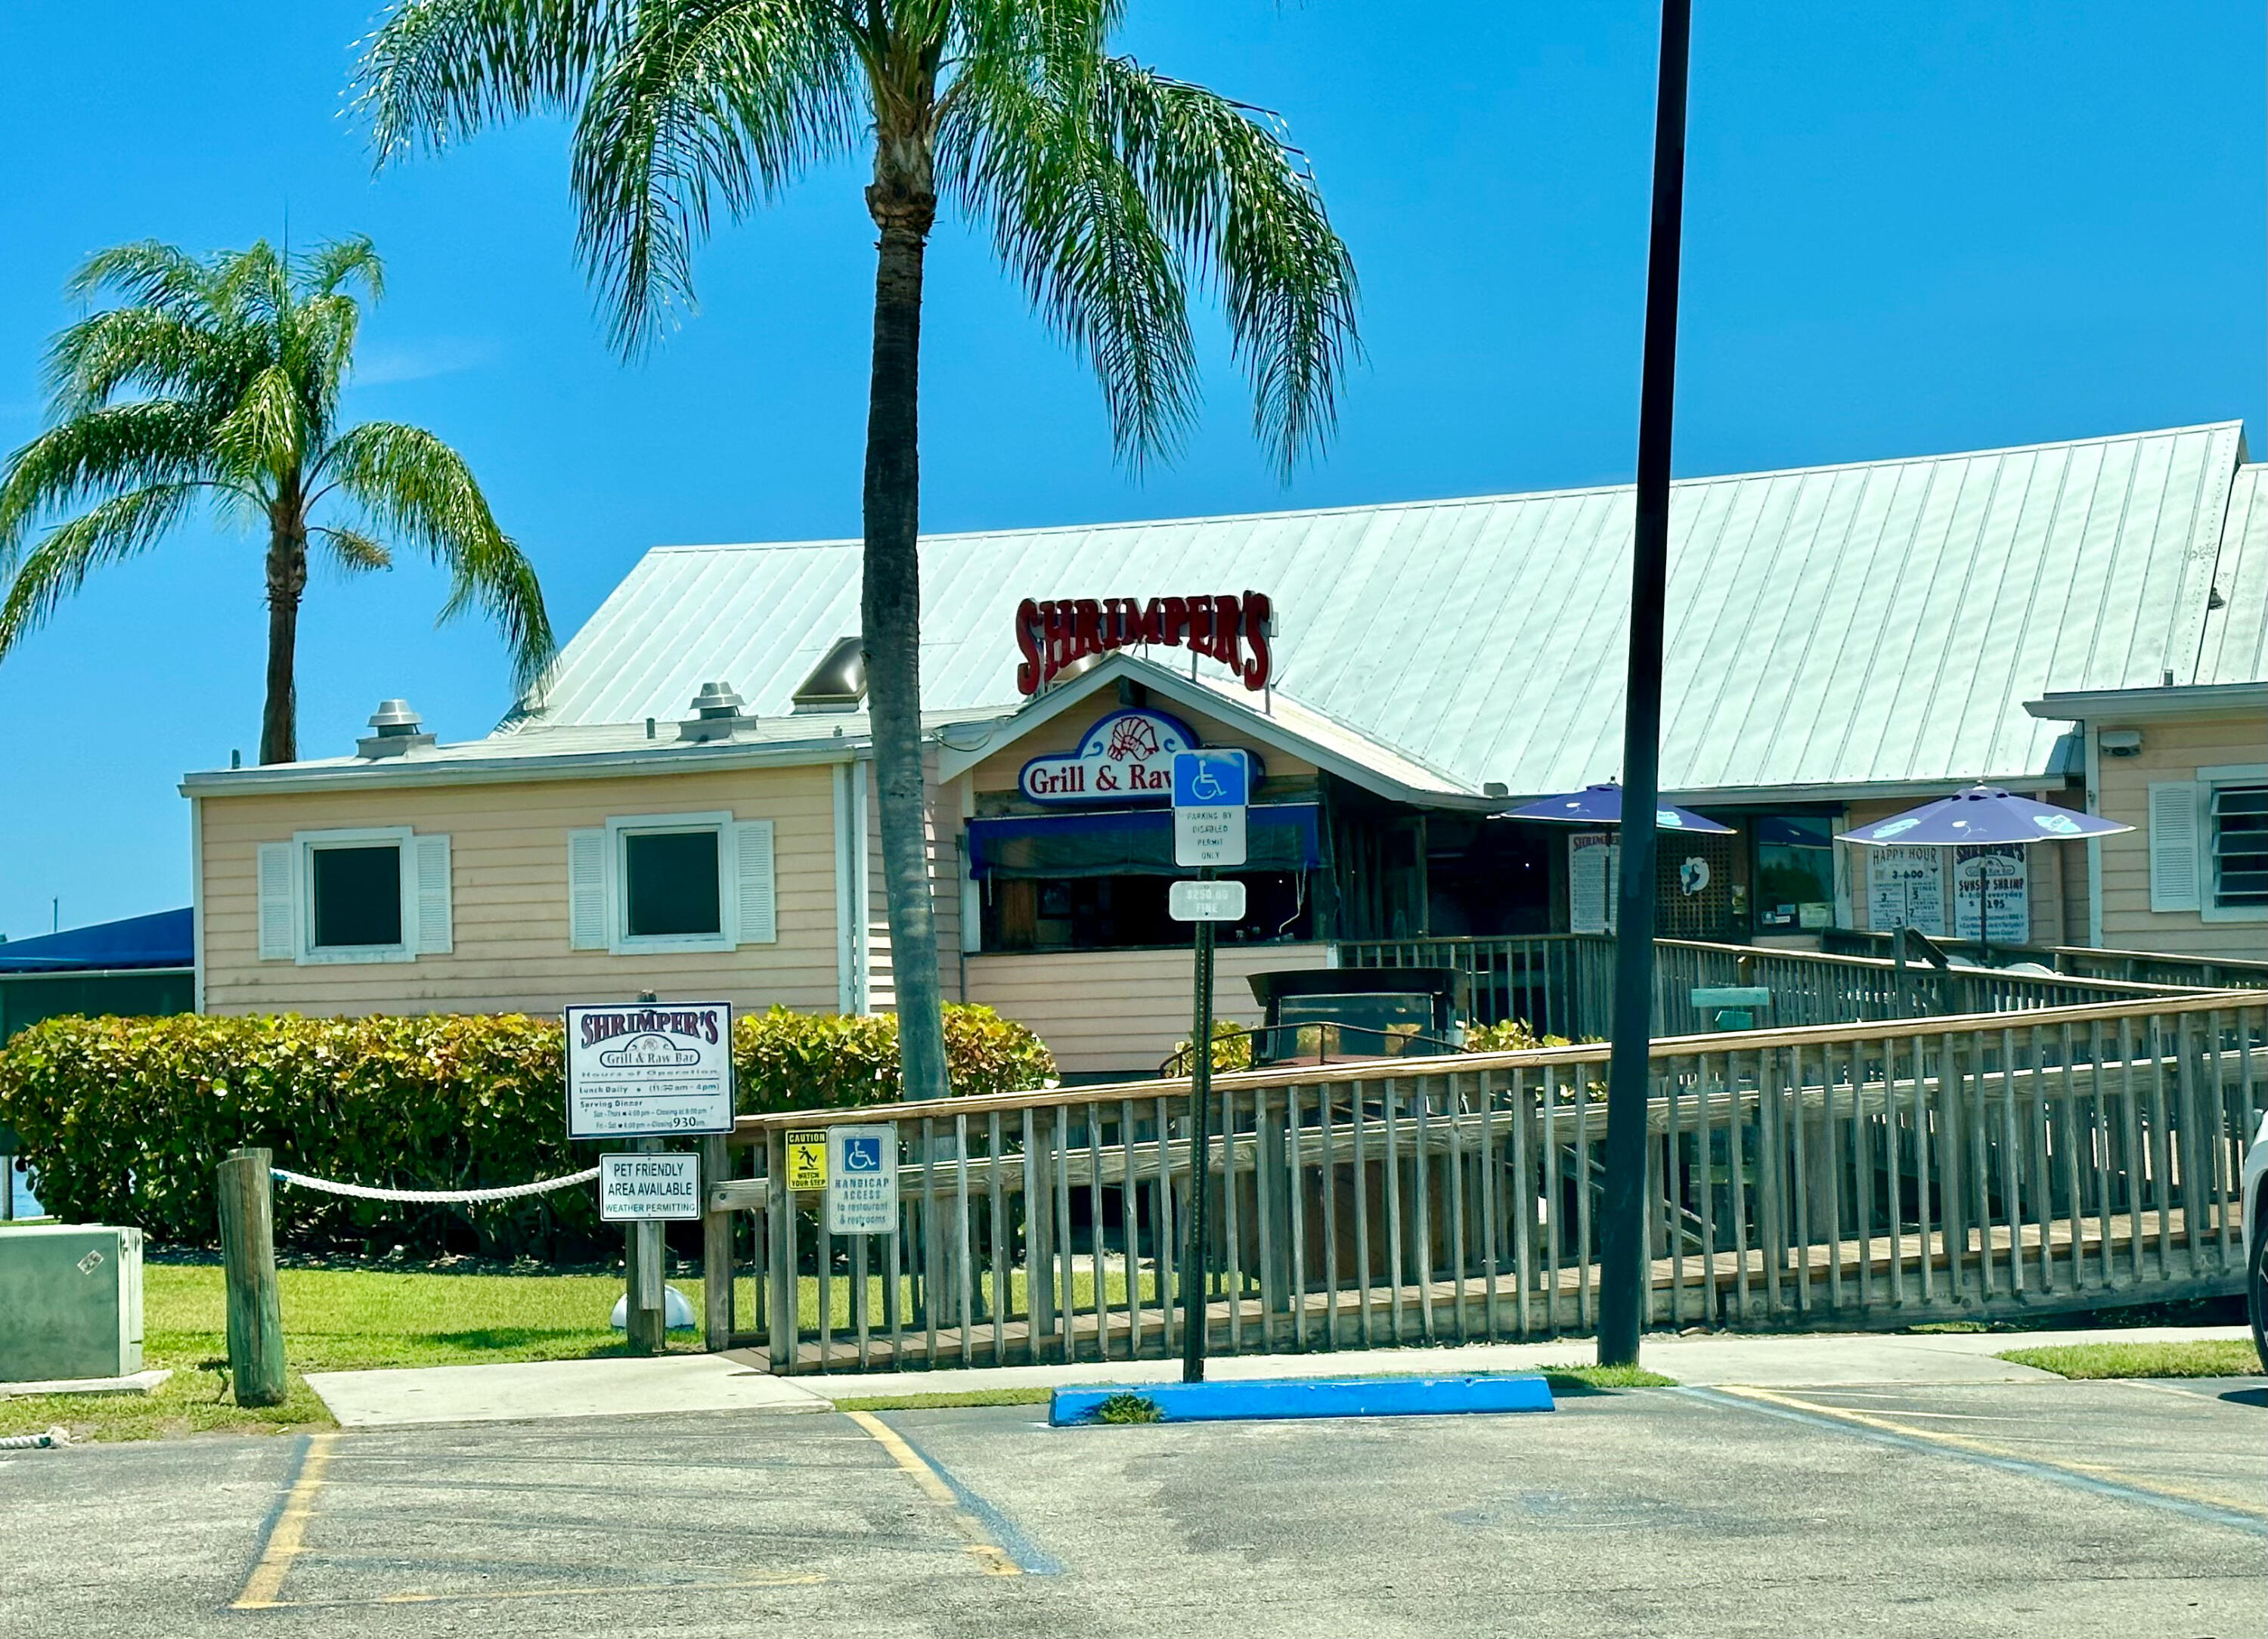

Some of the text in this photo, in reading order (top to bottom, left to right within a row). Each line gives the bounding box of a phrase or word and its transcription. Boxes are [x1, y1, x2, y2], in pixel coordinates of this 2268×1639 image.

[1030, 765, 1086, 794] Grill
[1096, 764, 1121, 791] &
[1187, 810, 1232, 820] PARKING BY
[1192, 825, 1228, 833] DISABLED
[1201, 851, 1219, 860] ONLY
[1873, 847, 1937, 866] HAPPY HOUR
[581, 1010, 718, 1049] SHRIMPER'S
[607, 1052, 694, 1064] Grill & Raw Bar
[605, 1086, 628, 1094] Daily
[580, 1101, 612, 1109] Serving
[673, 1116, 696, 1128] 930
[789, 1132, 826, 1143] CAUTION
[613, 1163, 684, 1177] PET FRIENDLY
[810, 1179, 826, 1187] STEP
[835, 1178, 890, 1188] HANDICAP
[608, 1182, 693, 1196] AREA AVAILABLE
[843, 1190, 881, 1201] ACCESS
[606, 1203, 696, 1213] WEATHER PERMITTING
[837, 1203, 845, 1212] to
[847, 1214, 886, 1224] restrooms
